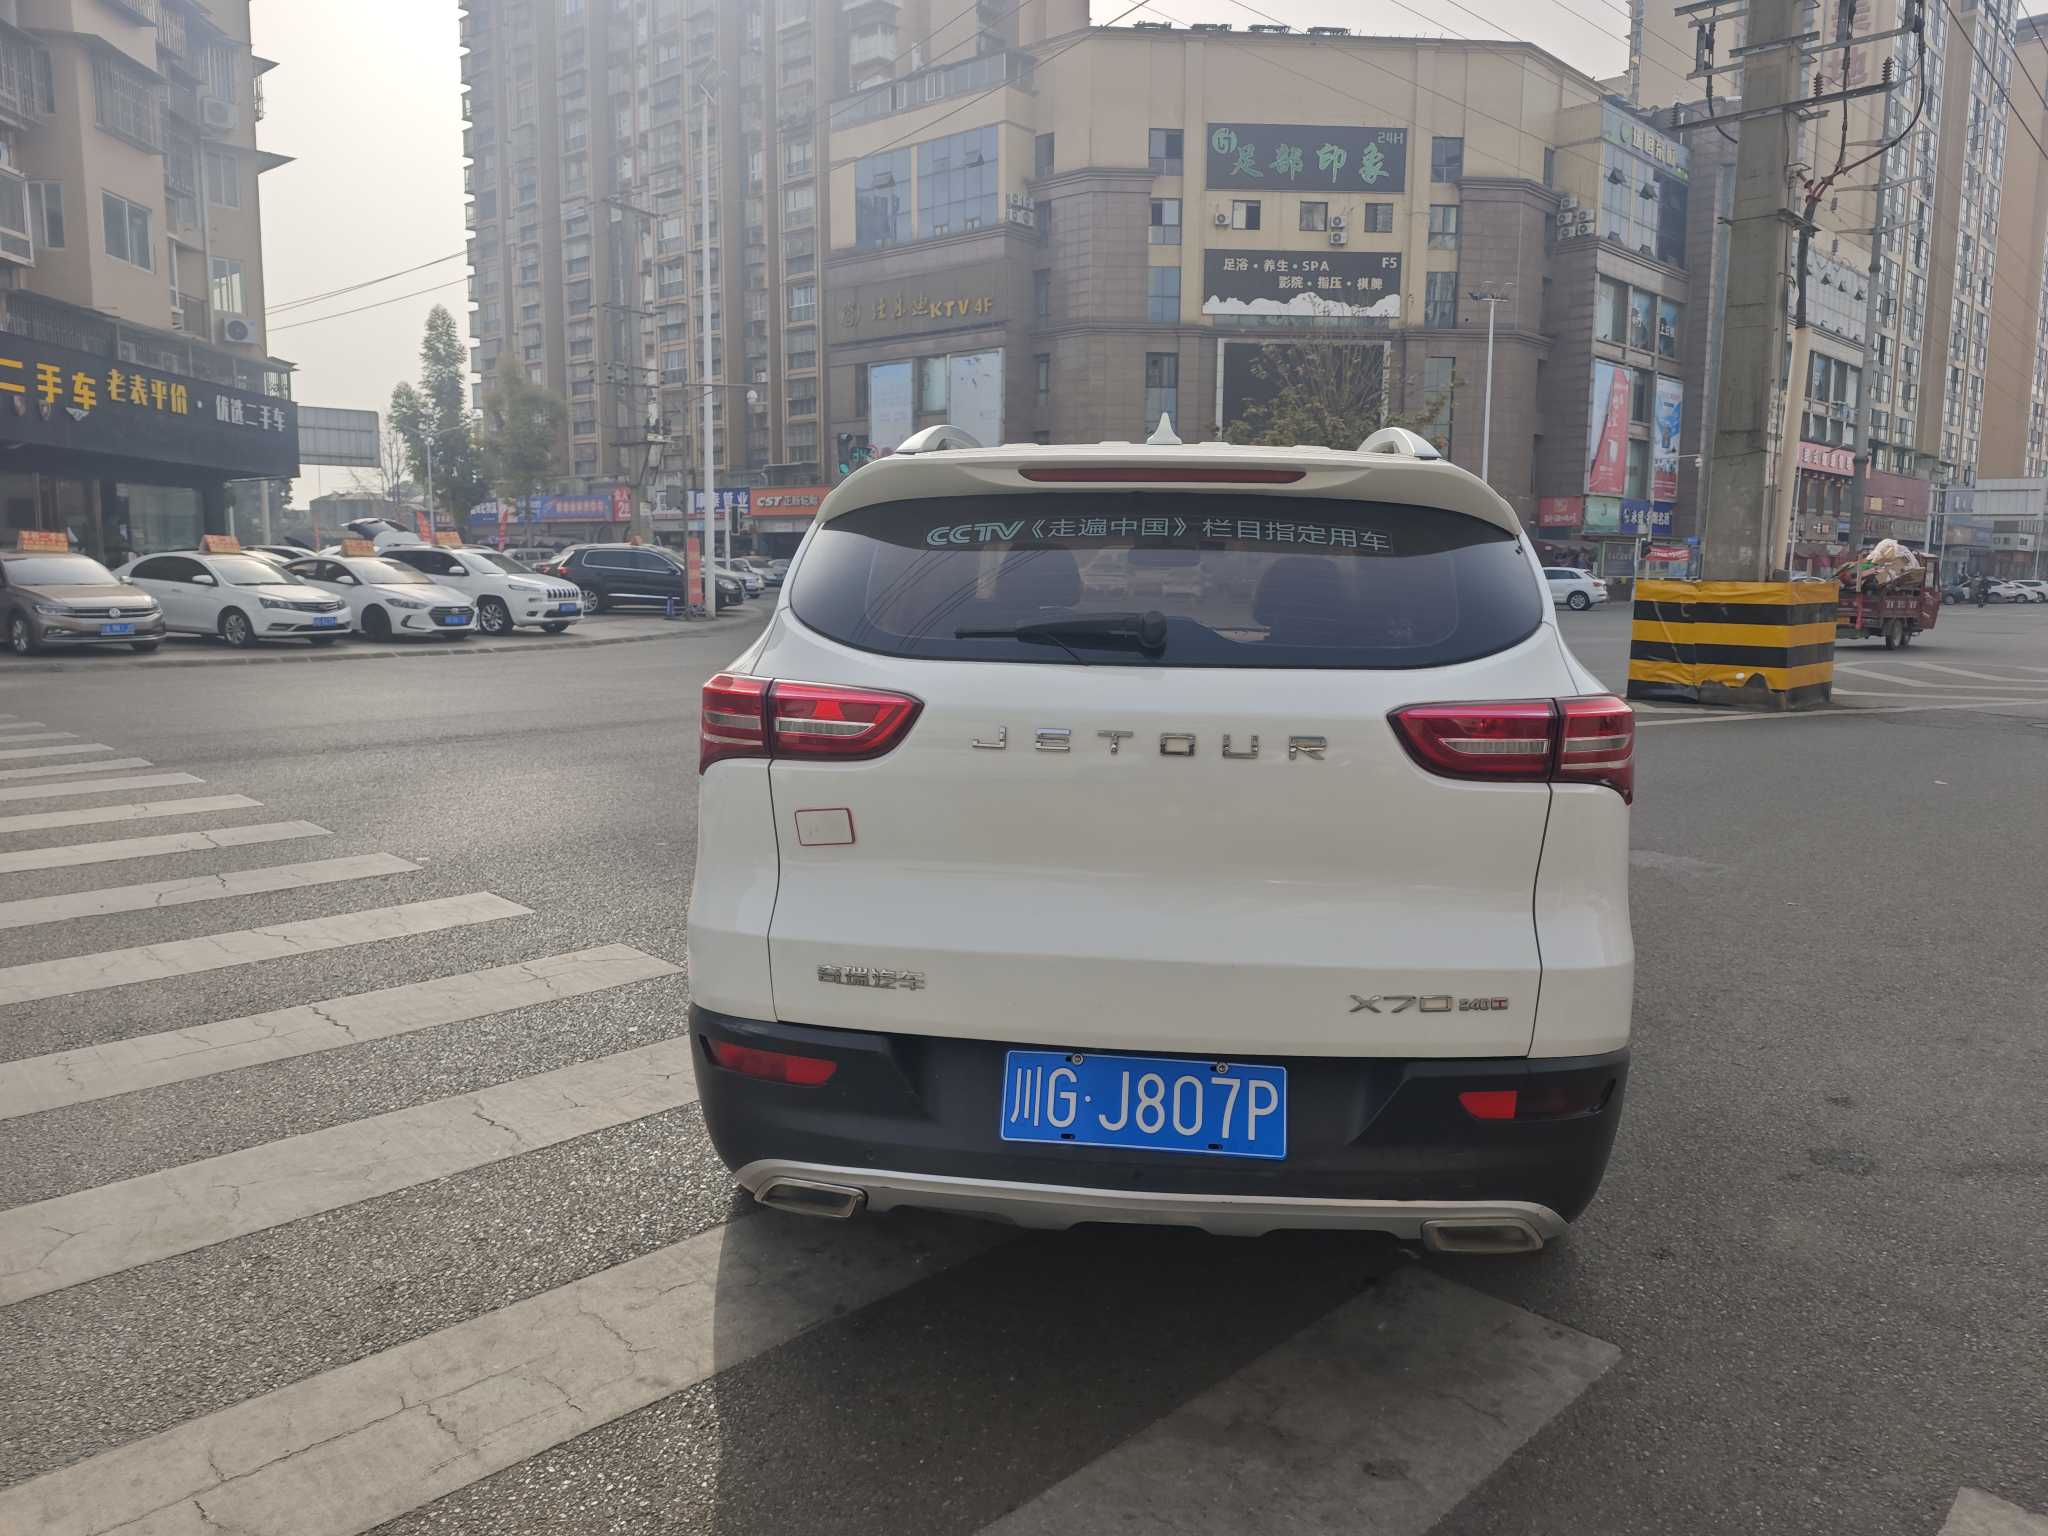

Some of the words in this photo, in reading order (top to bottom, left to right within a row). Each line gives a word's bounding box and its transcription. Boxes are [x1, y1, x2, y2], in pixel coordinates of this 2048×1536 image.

[1377, 131, 1404, 145] 24H
[1382, 256, 1398, 270] F5
[1349, 994, 1453, 1014] X70
